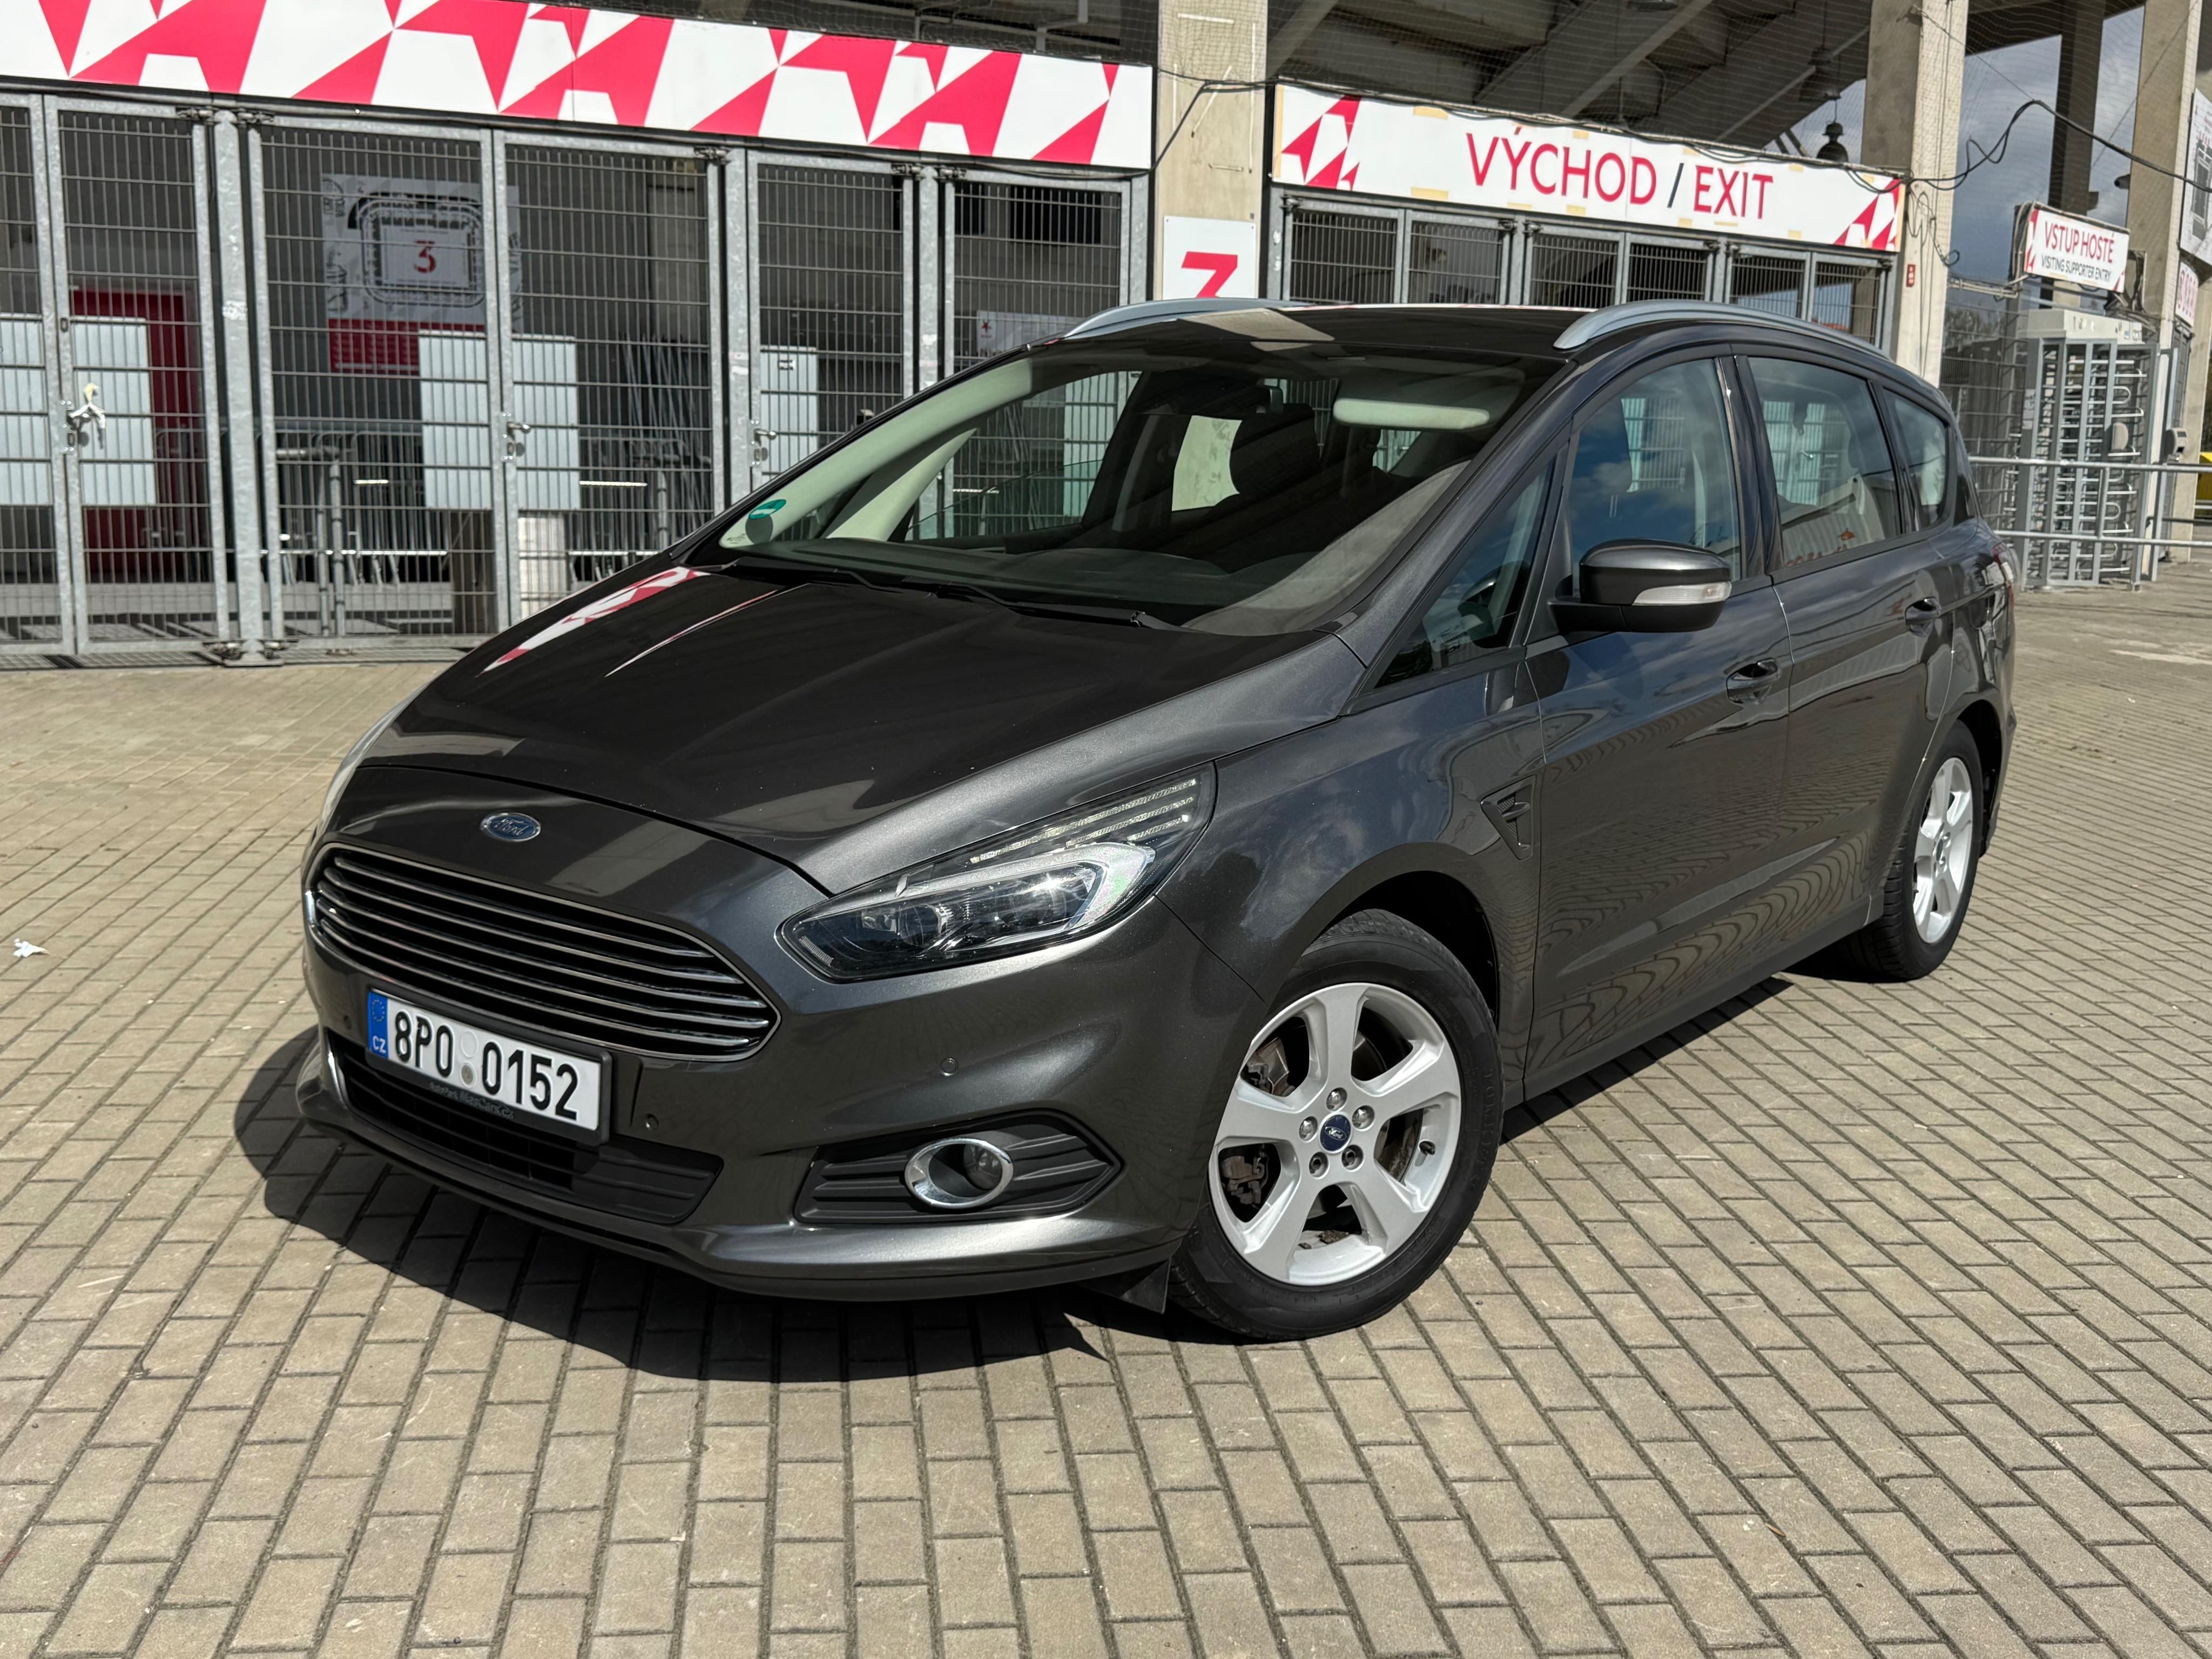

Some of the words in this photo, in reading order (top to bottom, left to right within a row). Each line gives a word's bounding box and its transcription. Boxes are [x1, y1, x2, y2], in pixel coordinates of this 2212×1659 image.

[1466, 125, 1658, 206] VÝCHOD
[1693, 164, 1775, 219] EXIT
[414, 239, 437, 274] 3
[2045, 221, 2080, 254] VSTUP
[2080, 231, 2115, 264] HOSTÉ
[2041, 254, 2065, 272] VISITING
[2065, 260, 2095, 279] SUPPORTER
[2095, 267, 2112, 282] ENTRY
[373, 1035, 387, 1054] CZ
[395, 1011, 454, 1078] 8P0
[482, 1041, 578, 1121] 0152
[1328, 1128, 1344, 1139] Ford
